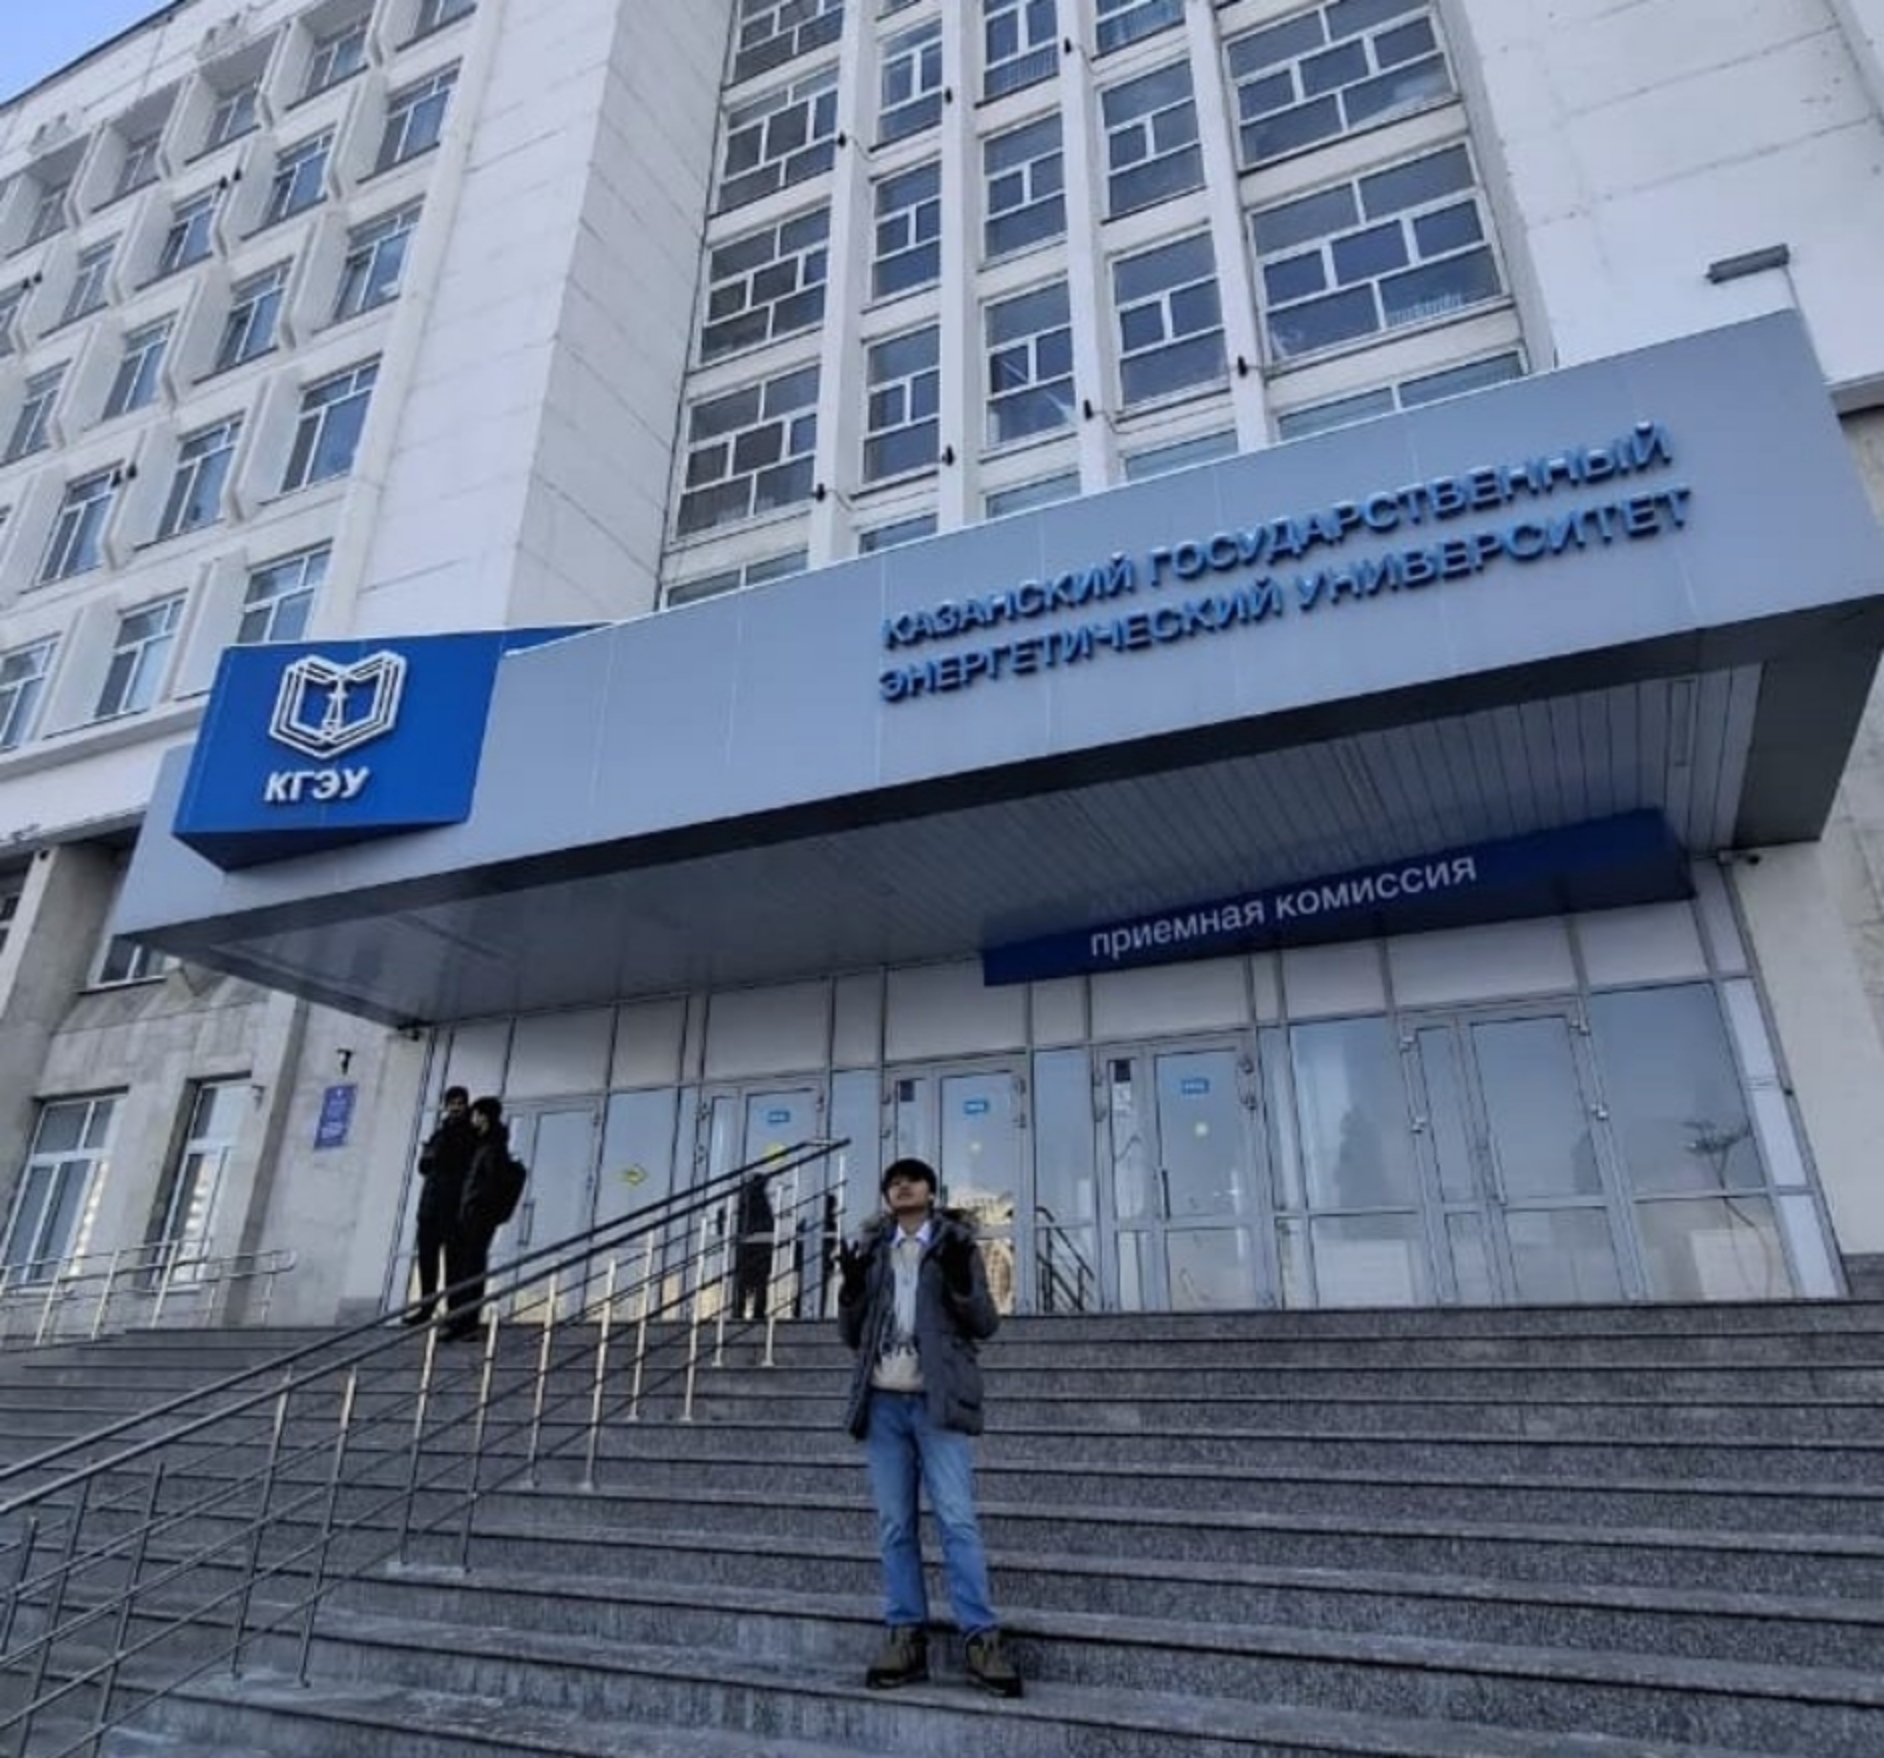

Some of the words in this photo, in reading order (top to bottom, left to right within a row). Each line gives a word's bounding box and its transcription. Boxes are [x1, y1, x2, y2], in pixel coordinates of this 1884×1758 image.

[879, 576, 1284, 702] ЭНЕРГЕТИЧЕСКИЙ
[1296, 482, 1692, 612] УНИВЕРСИТЕТ
[881, 551, 1137, 650] КАЗАНСКИЙ
[1150, 420, 1674, 588] ГОСУДАРСТВЕННЫЙ
[263, 766, 371, 803] КГЭУ
[1090, 898, 1267, 960] приемная
[1275, 855, 1479, 921] комиссия
